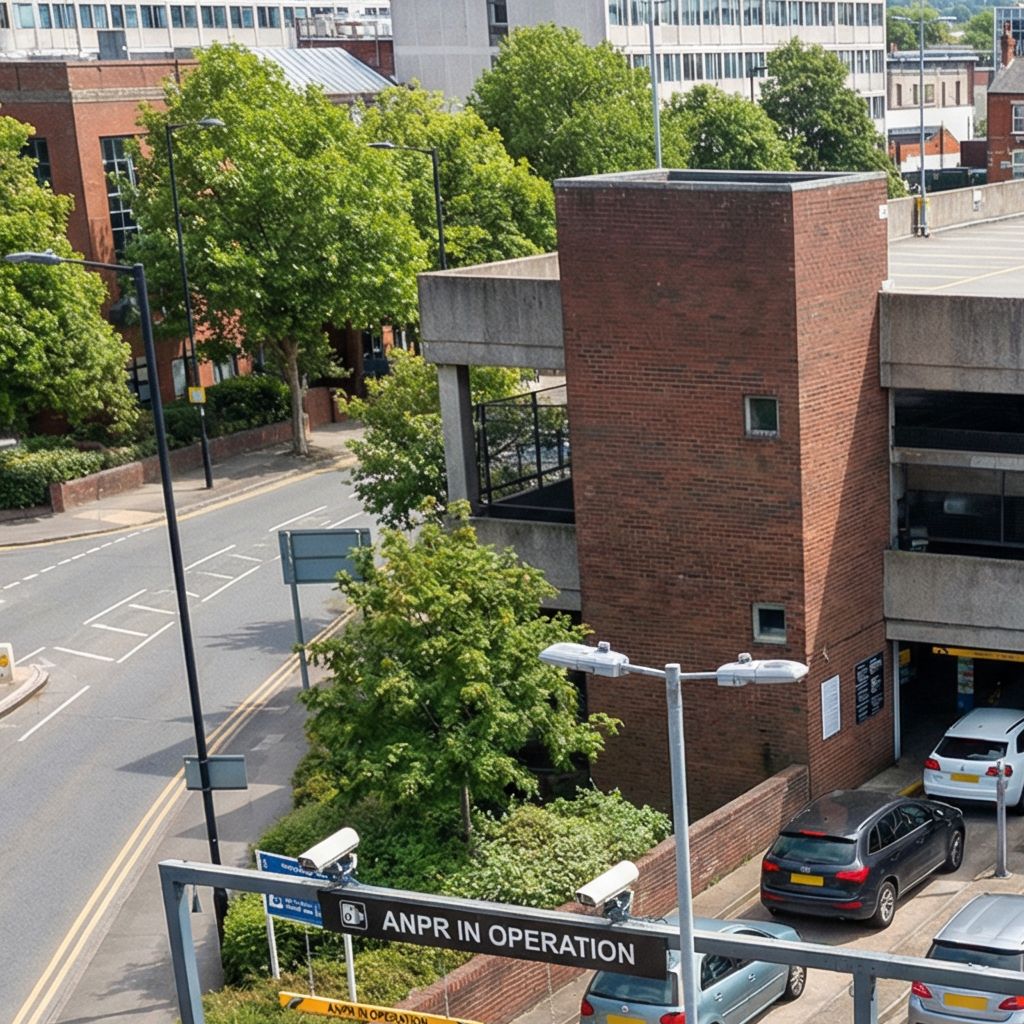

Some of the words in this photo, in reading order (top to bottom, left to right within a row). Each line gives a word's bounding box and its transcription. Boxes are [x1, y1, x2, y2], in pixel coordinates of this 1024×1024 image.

[381, 910, 452, 940] ANPR
[457, 918, 482, 944] IN
[488, 924, 636, 966] OPERATION
